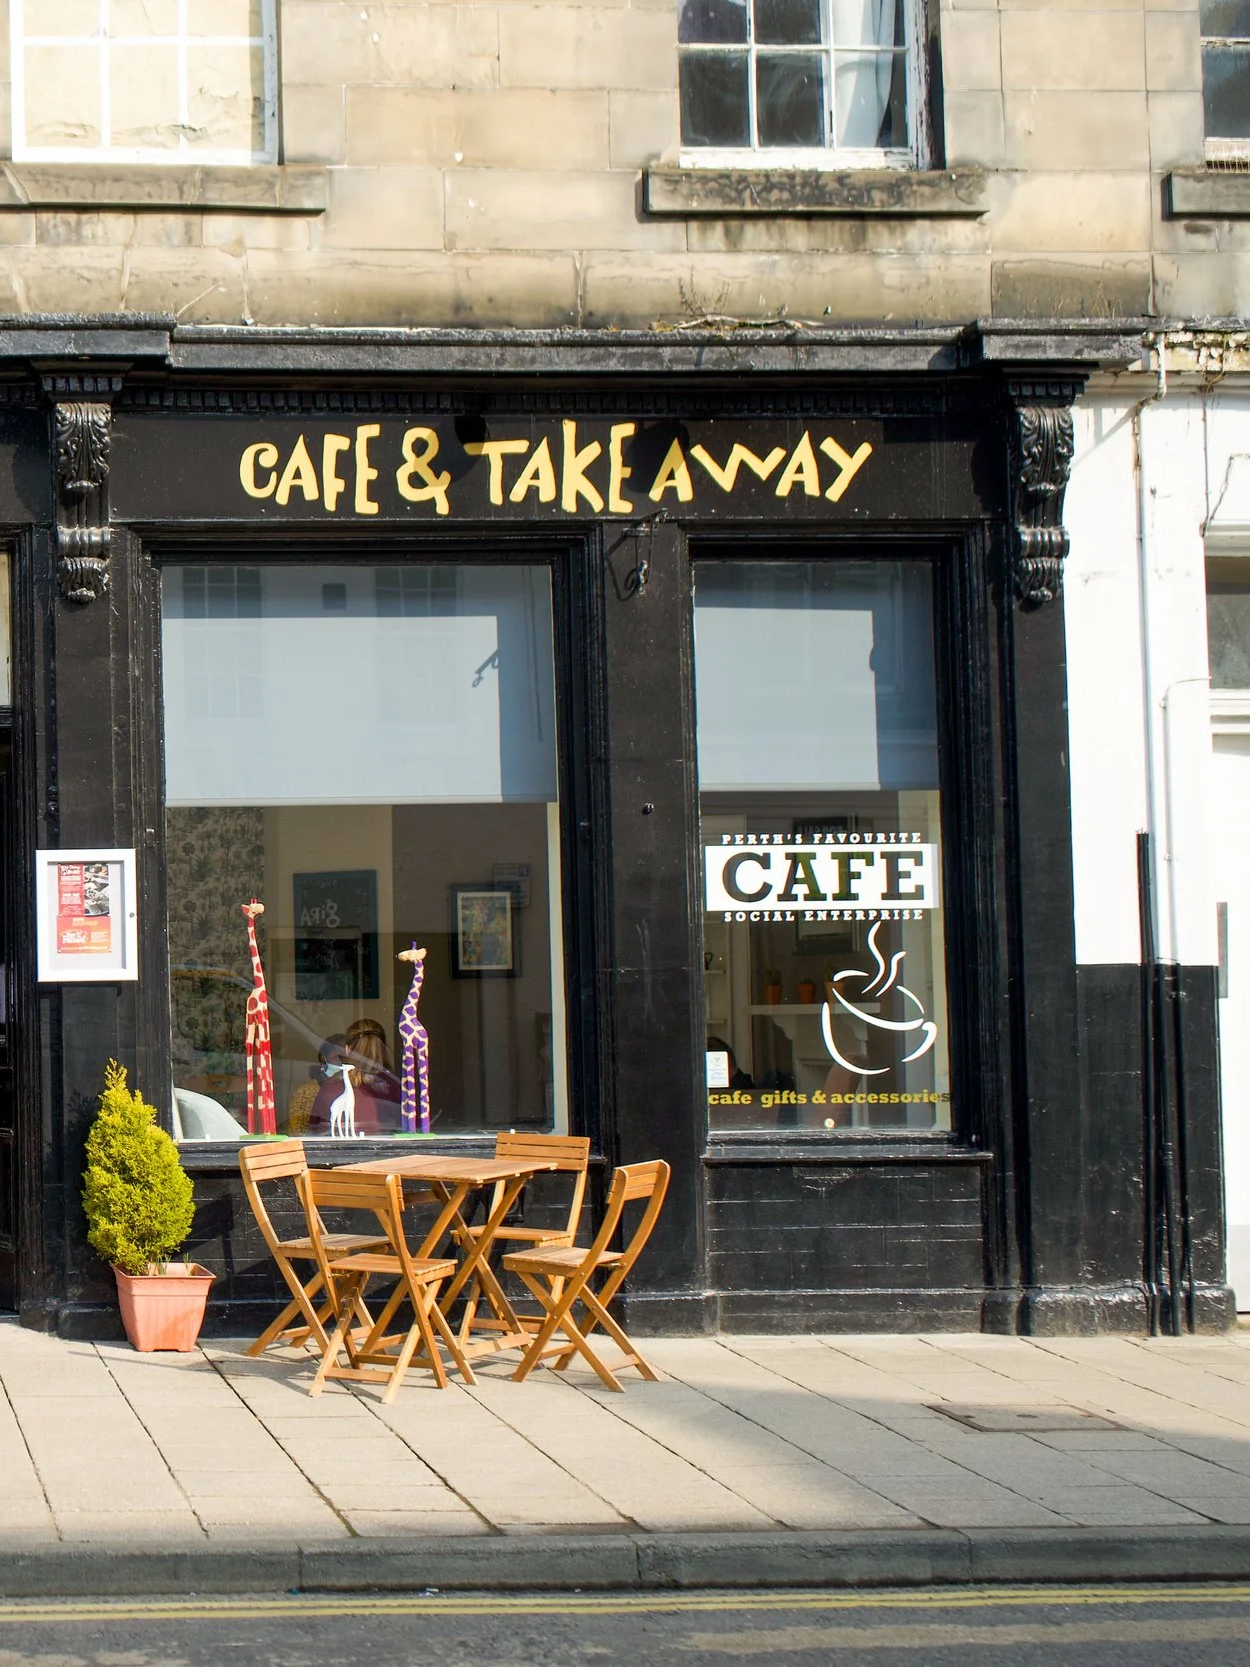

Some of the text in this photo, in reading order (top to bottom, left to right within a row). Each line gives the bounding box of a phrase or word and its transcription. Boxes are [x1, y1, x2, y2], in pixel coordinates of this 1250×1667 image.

[239, 423, 381, 515] CAFE
[395, 425, 451, 516] &
[722, 832, 922, 845] PERTH'S FAVOURITE
[722, 851, 925, 902] CAFE
[724, 909, 923, 922] SOCIAL ENTERPRISE
[708, 1088, 950, 1108] cafe gifts & accessories
